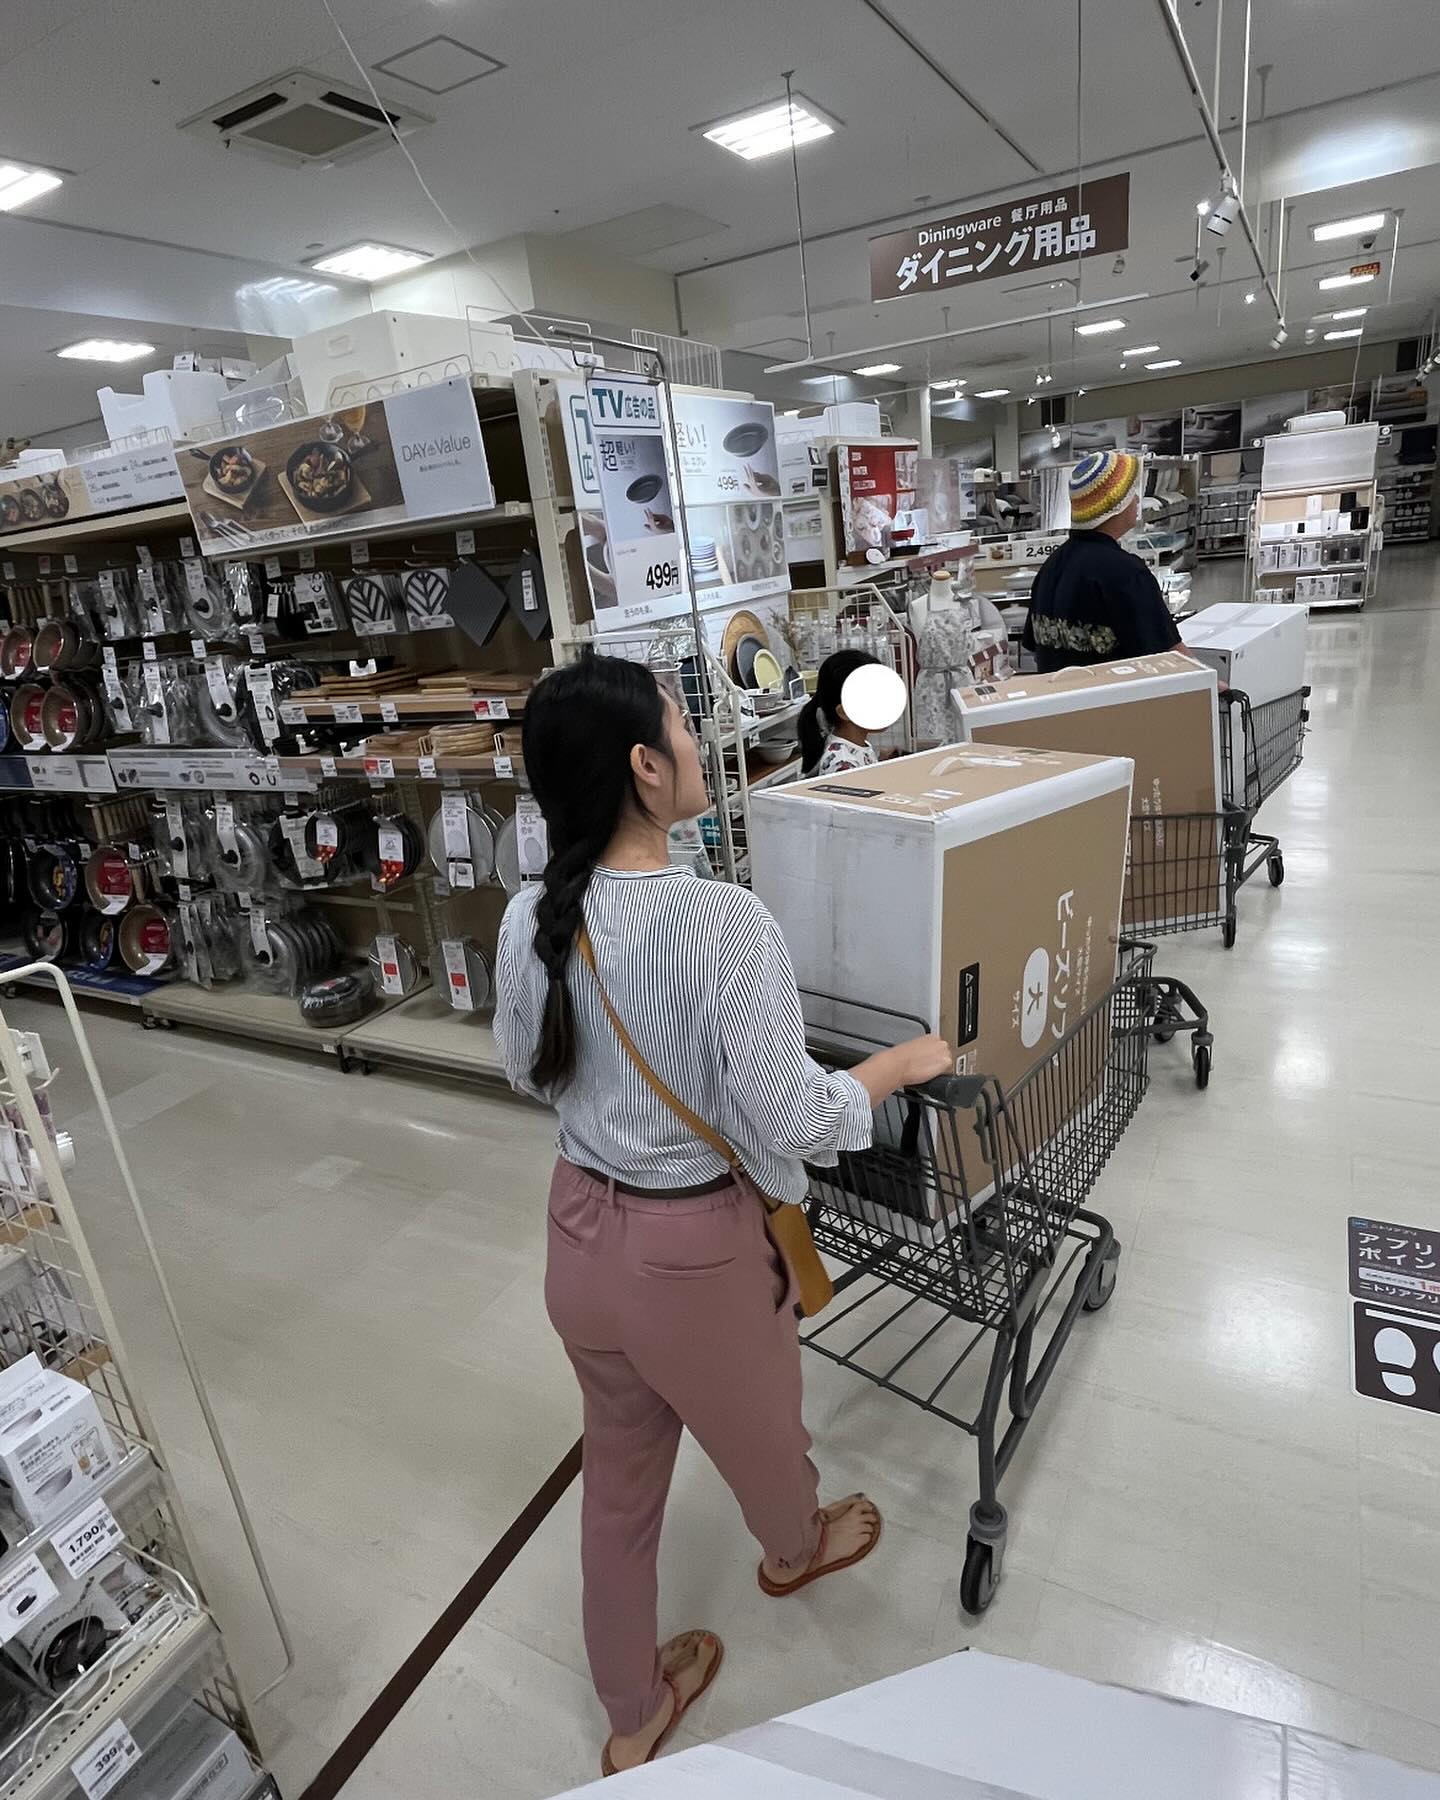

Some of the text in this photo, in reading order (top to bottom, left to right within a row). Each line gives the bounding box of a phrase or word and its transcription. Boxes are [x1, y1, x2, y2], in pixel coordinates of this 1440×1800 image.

[1011, 196, 1068, 224] 餐厅用品
[918, 214, 1002, 246] Diningware
[896, 214, 1096, 291] ダイニング用品
[645, 562, 679, 590] 499円
[1051, 888, 1074, 1066] ビーズソフ
[1026, 981, 1044, 1016] 大
